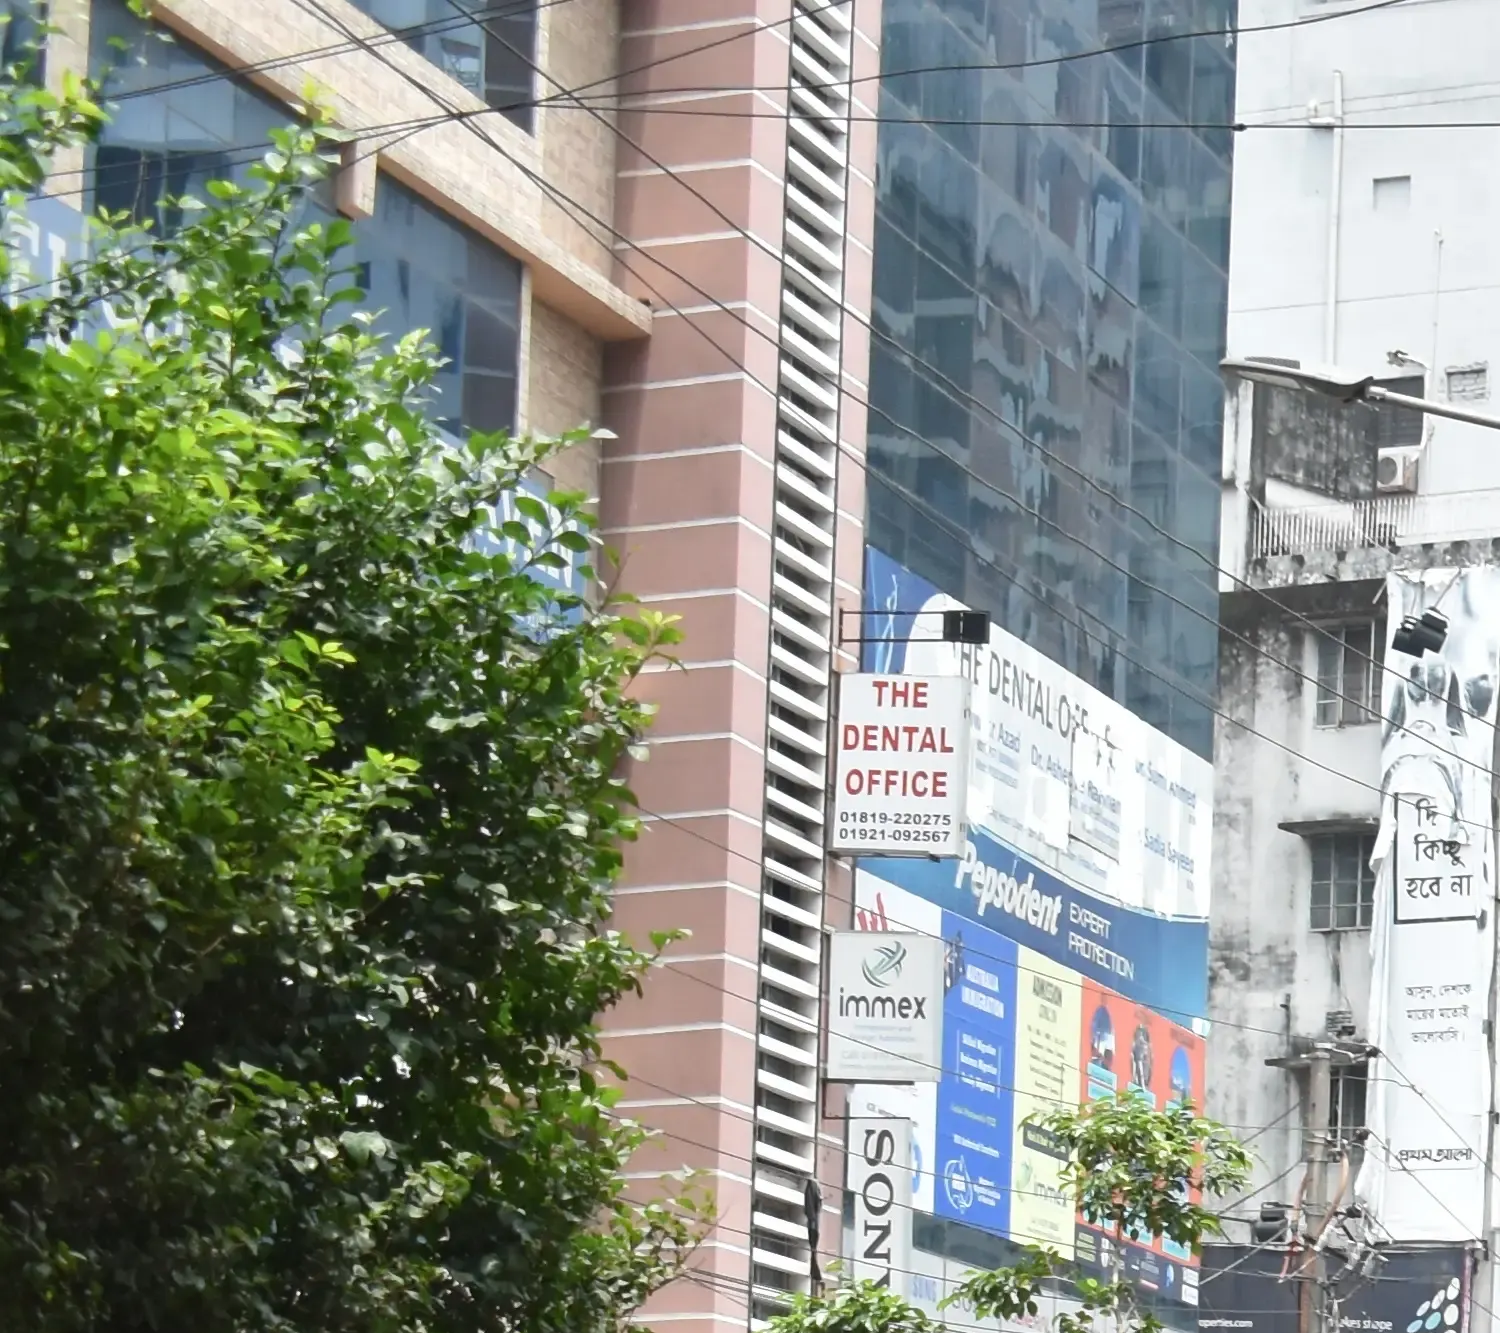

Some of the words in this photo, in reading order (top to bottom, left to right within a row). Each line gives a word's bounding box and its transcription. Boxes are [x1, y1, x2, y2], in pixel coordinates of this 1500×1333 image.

[872, 680, 929, 708] THE
[988, 649, 1054, 731] DENTAL
[842, 724, 954, 753] DENTAL
[845, 768, 948, 798] OFFICE
[839, 811, 951, 827] 01819-220275
[839, 827, 951, 843] 01921-092567
[954, 840, 1063, 936] Pepsodent
[1404, 876, 1443, 899] হবে
[1450, 874, 1474, 896] না
[1069, 901, 1112, 940] EXPERT
[1067, 933, 1135, 982] PROTECTION
[839, 987, 927, 1021] immex
